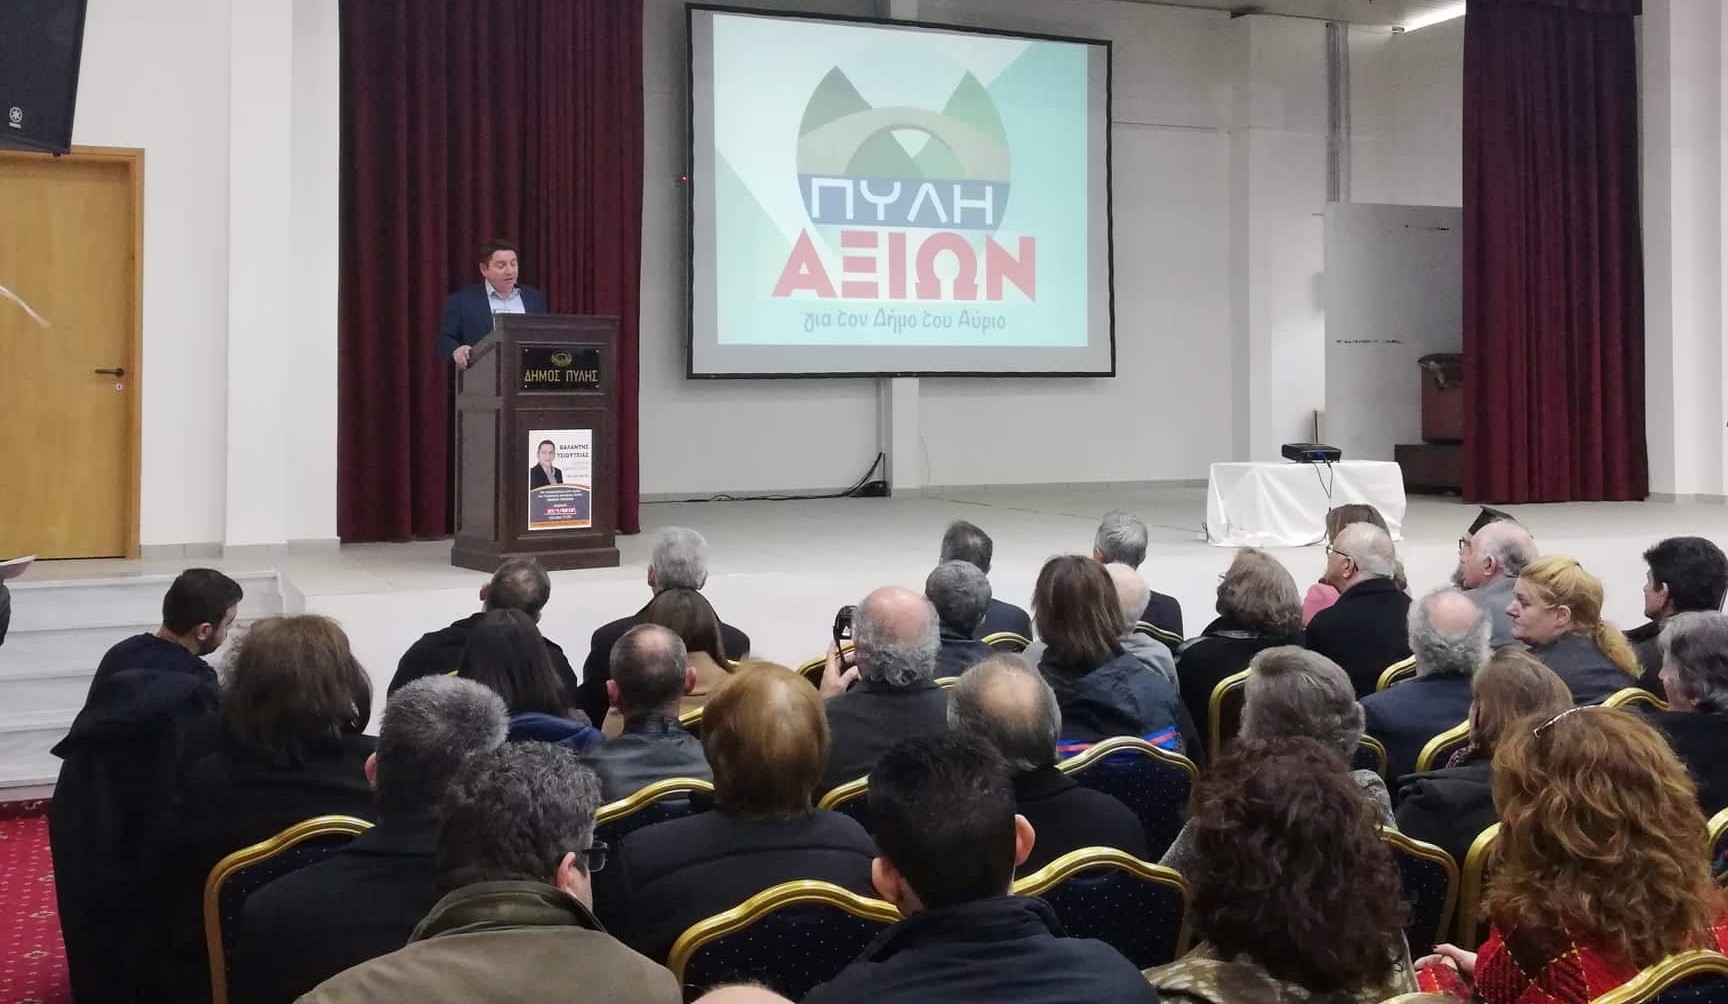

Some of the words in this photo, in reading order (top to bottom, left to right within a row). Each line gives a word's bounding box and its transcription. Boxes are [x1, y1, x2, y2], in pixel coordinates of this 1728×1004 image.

[811, 177, 993, 226] ΠΥΛΗ
[771, 227, 1037, 302] ΑΞΙΩΝ
[803, 311, 832, 332] για
[837, 309, 868, 328] τον
[873, 307, 917, 334] Δήμο
[922, 310, 952, 329] του
[957, 309, 1006, 335] Αύριο
[524, 369, 561, 382] ΔΗΜΟΣ
[566, 369, 598, 382] ΠΥΛΗΣ
